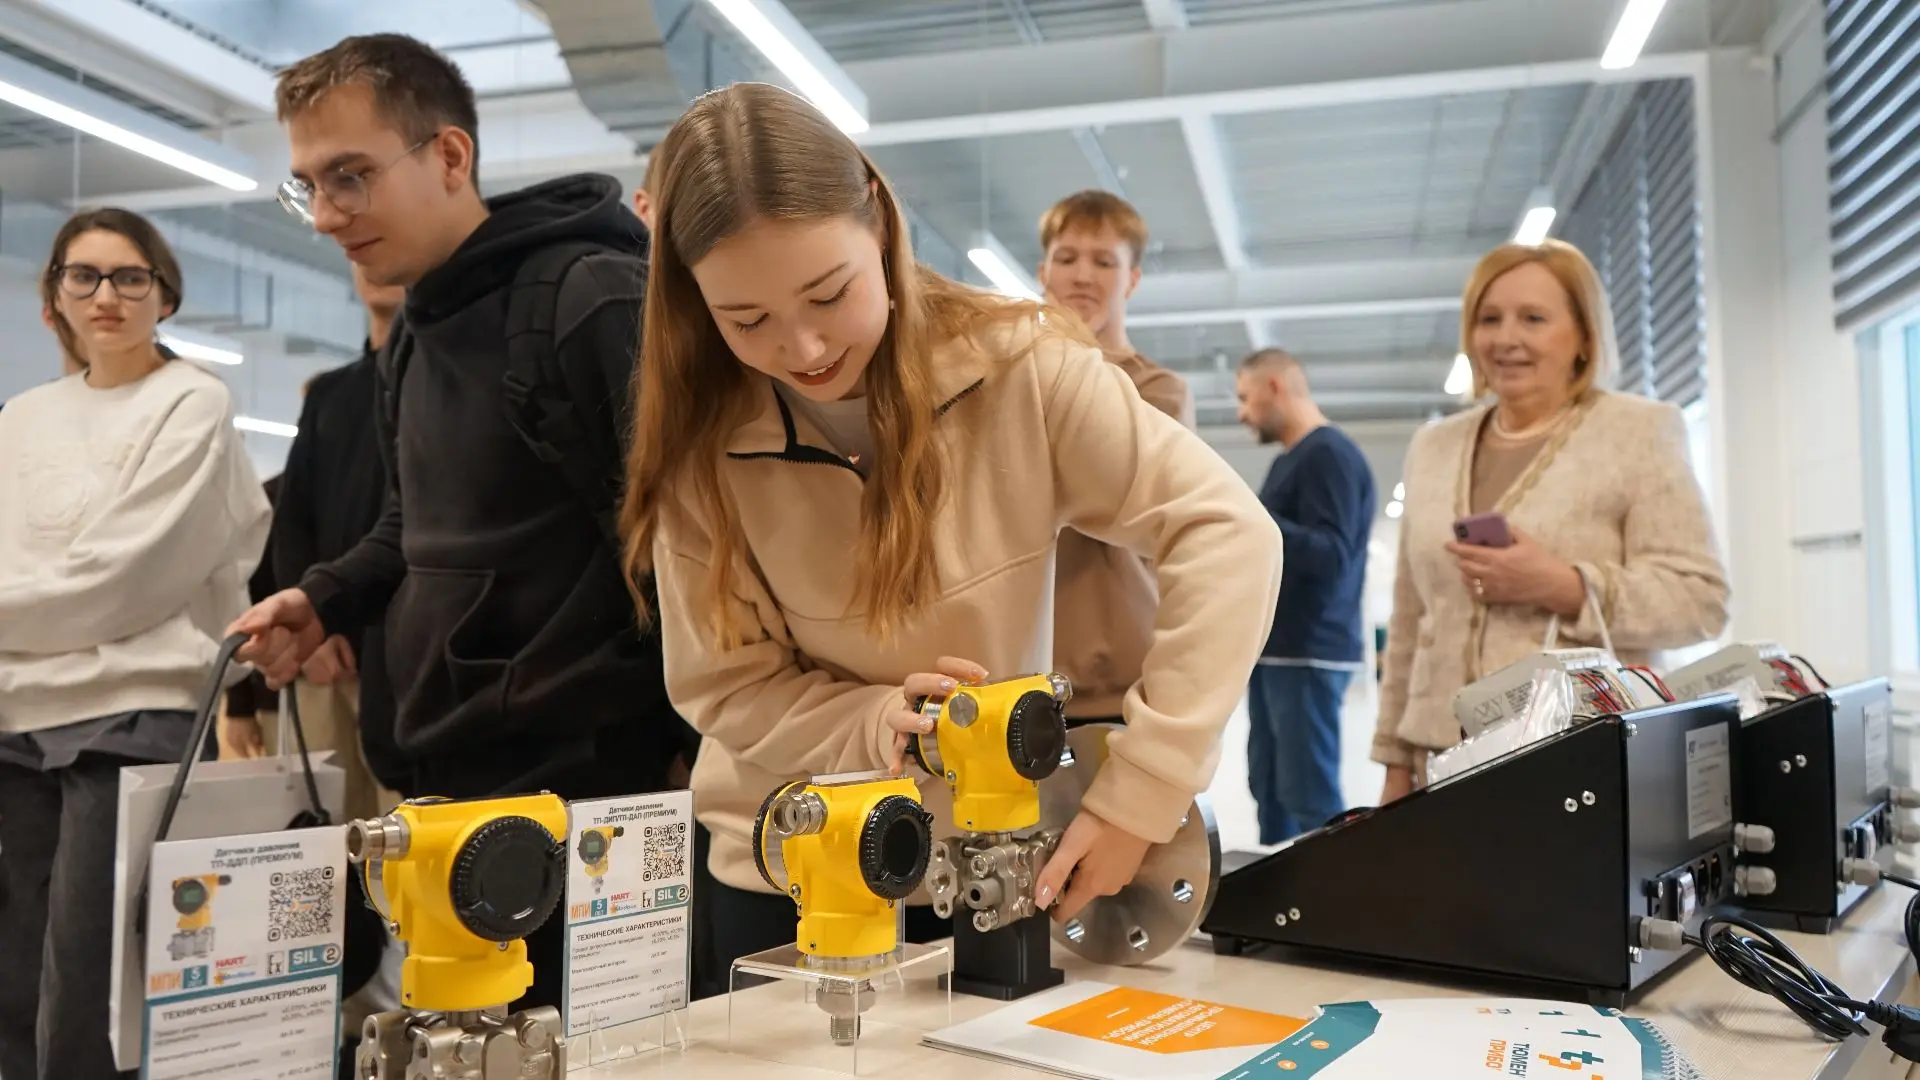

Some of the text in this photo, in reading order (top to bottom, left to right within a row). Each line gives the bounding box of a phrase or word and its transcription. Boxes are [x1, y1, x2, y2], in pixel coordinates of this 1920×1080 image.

[643, 808, 678, 820] (ПРЕМИУМ)
[611, 892, 630, 902] HART
[657, 887, 686, 901] SIL 2
[572, 903, 590, 919] МПИ
[597, 899, 602, 909] 5
[577, 916, 682, 942] ТЕХНИЧЕСКИЕ ХАРАКТЕРИСТИКИ
[216, 956, 247, 969] HART
[292, 948, 336, 965] SIL 2
[161, 984, 327, 1021] ТЕХНИЧЕСКИЕ ХАРАКТЕРИСТИКИ
[1485, 1039, 1507, 1071] ПРИБО
[1509, 1043, 1530, 1078] ТЮМЕН
